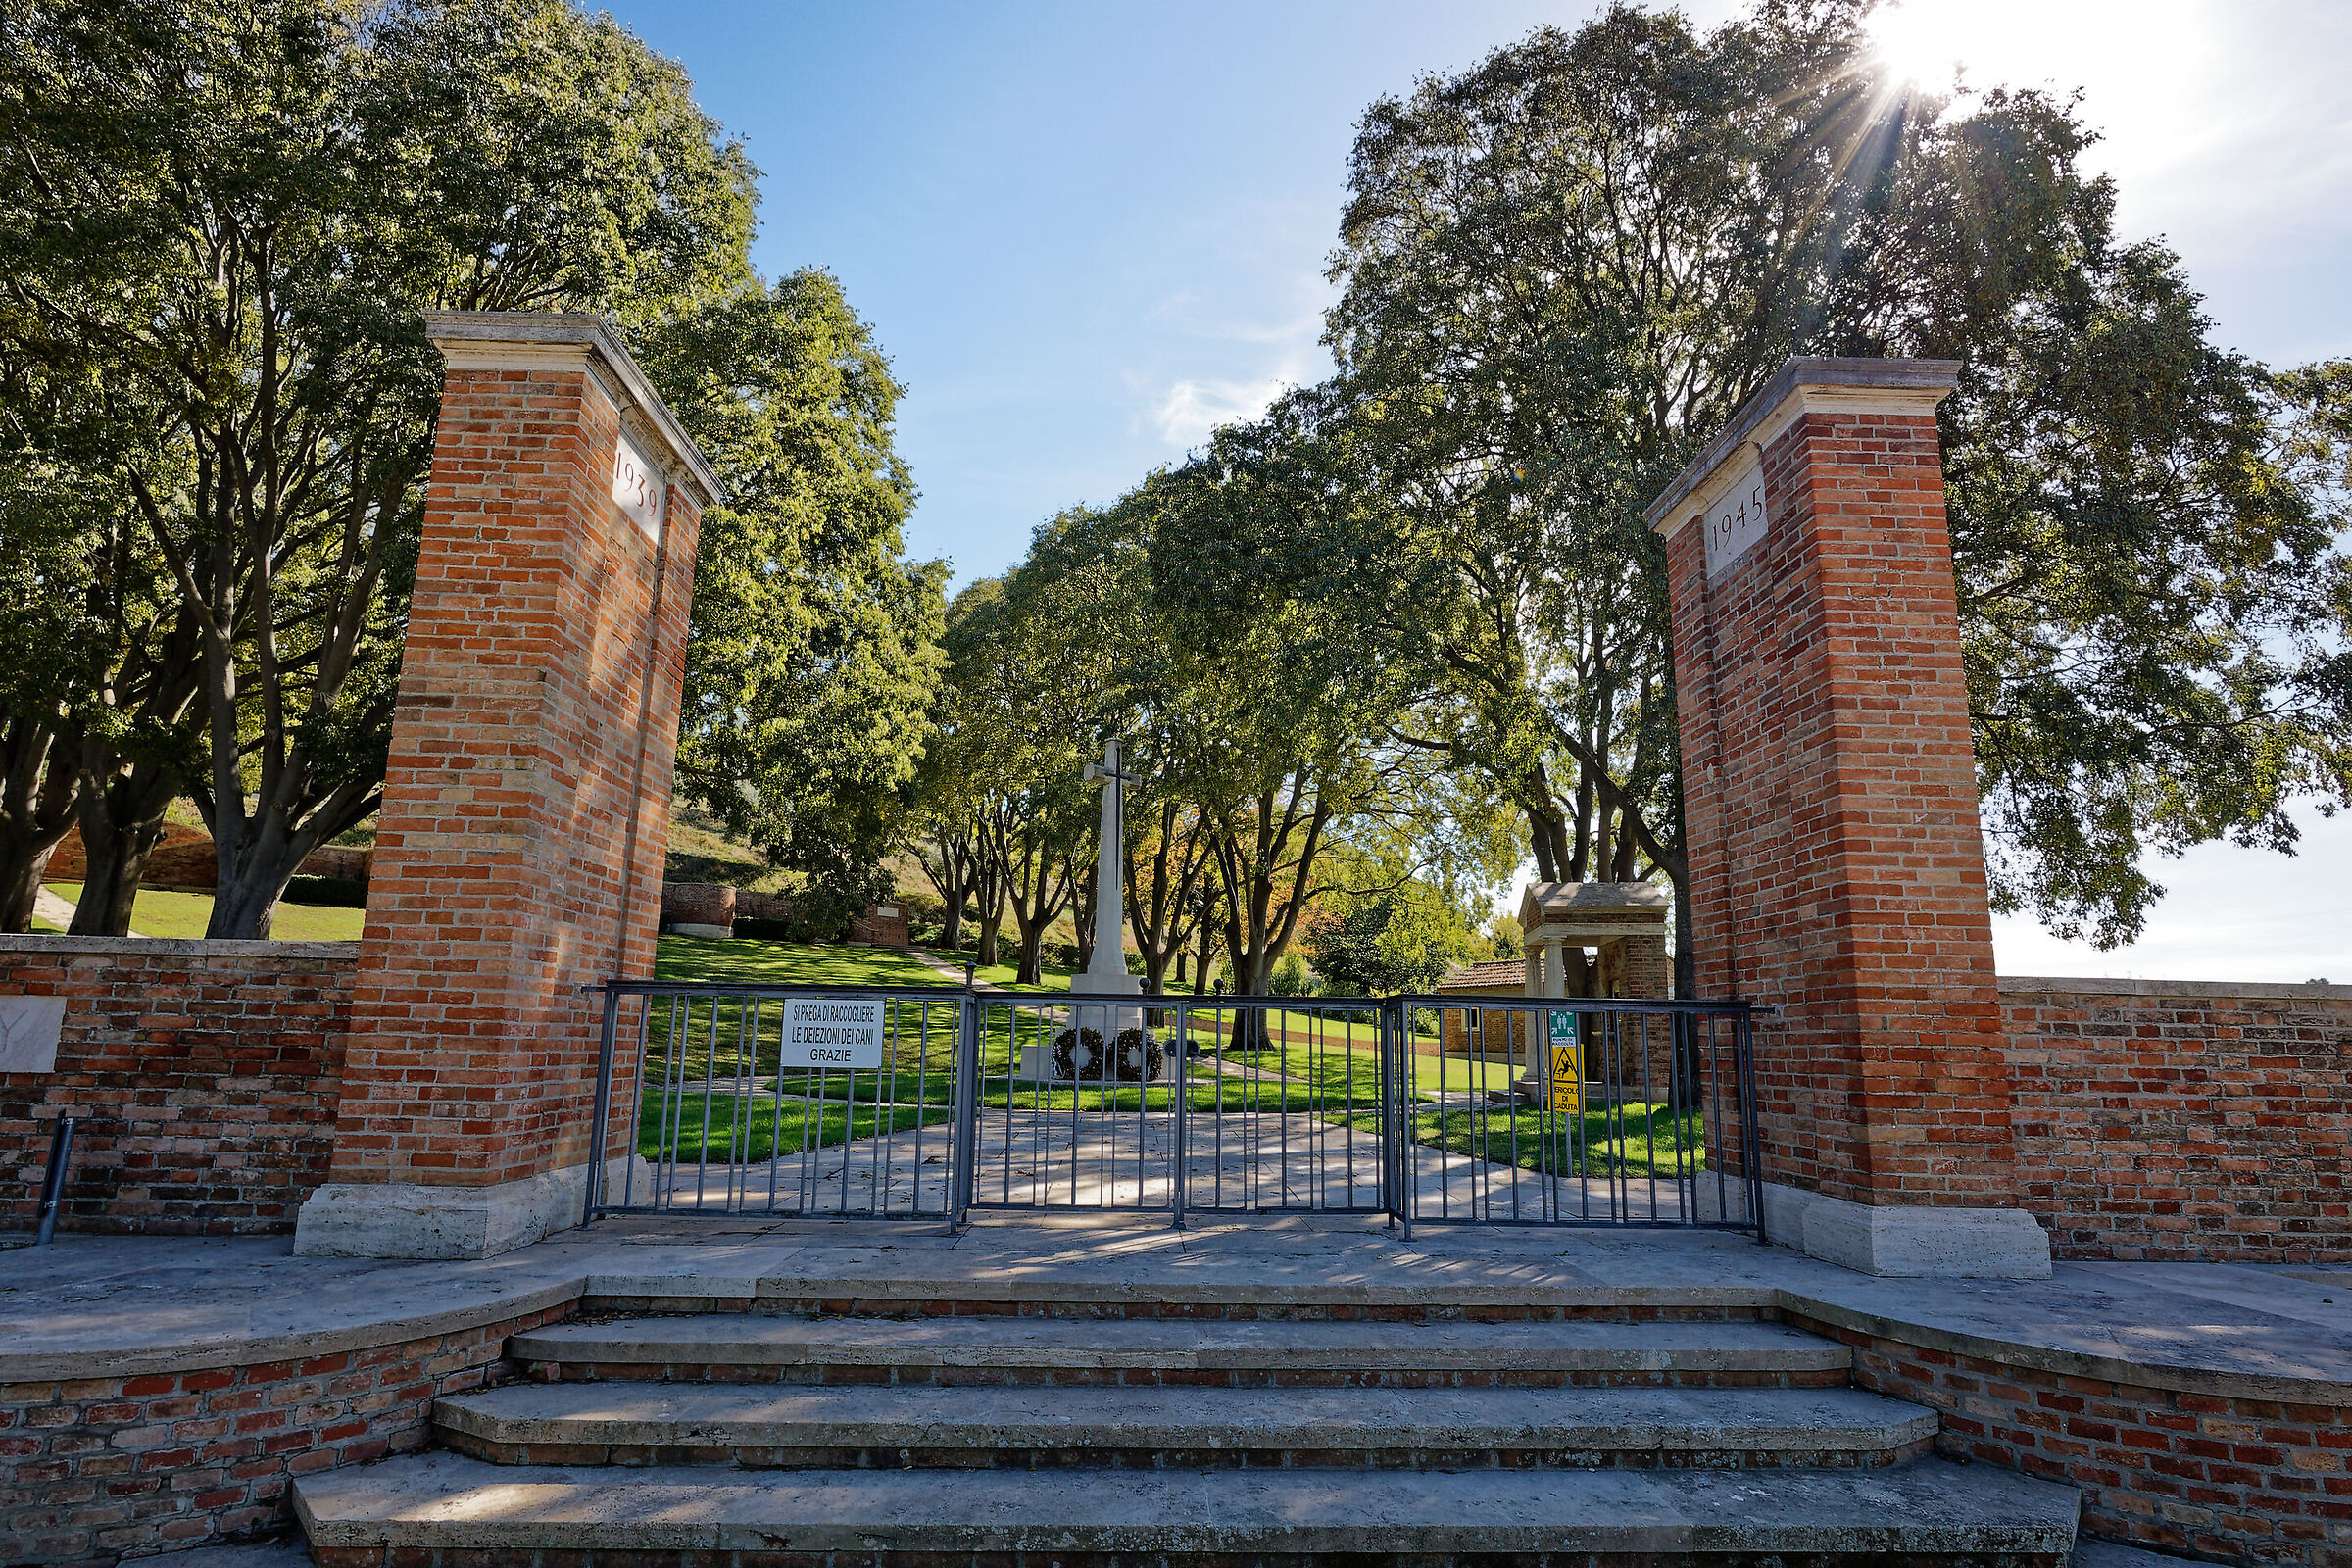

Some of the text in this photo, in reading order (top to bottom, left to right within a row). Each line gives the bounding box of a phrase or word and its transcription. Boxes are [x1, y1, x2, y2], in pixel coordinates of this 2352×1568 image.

[615, 451, 657, 517] 1939
[1713, 485, 1763, 552] 1945
[793, 1004, 874, 1023] SI PREGA DI RACCOGLIERE
[792, 1027, 874, 1046] LE DEIEZIONI DEI CANI
[810, 1049, 852, 1062] GRAZIE
